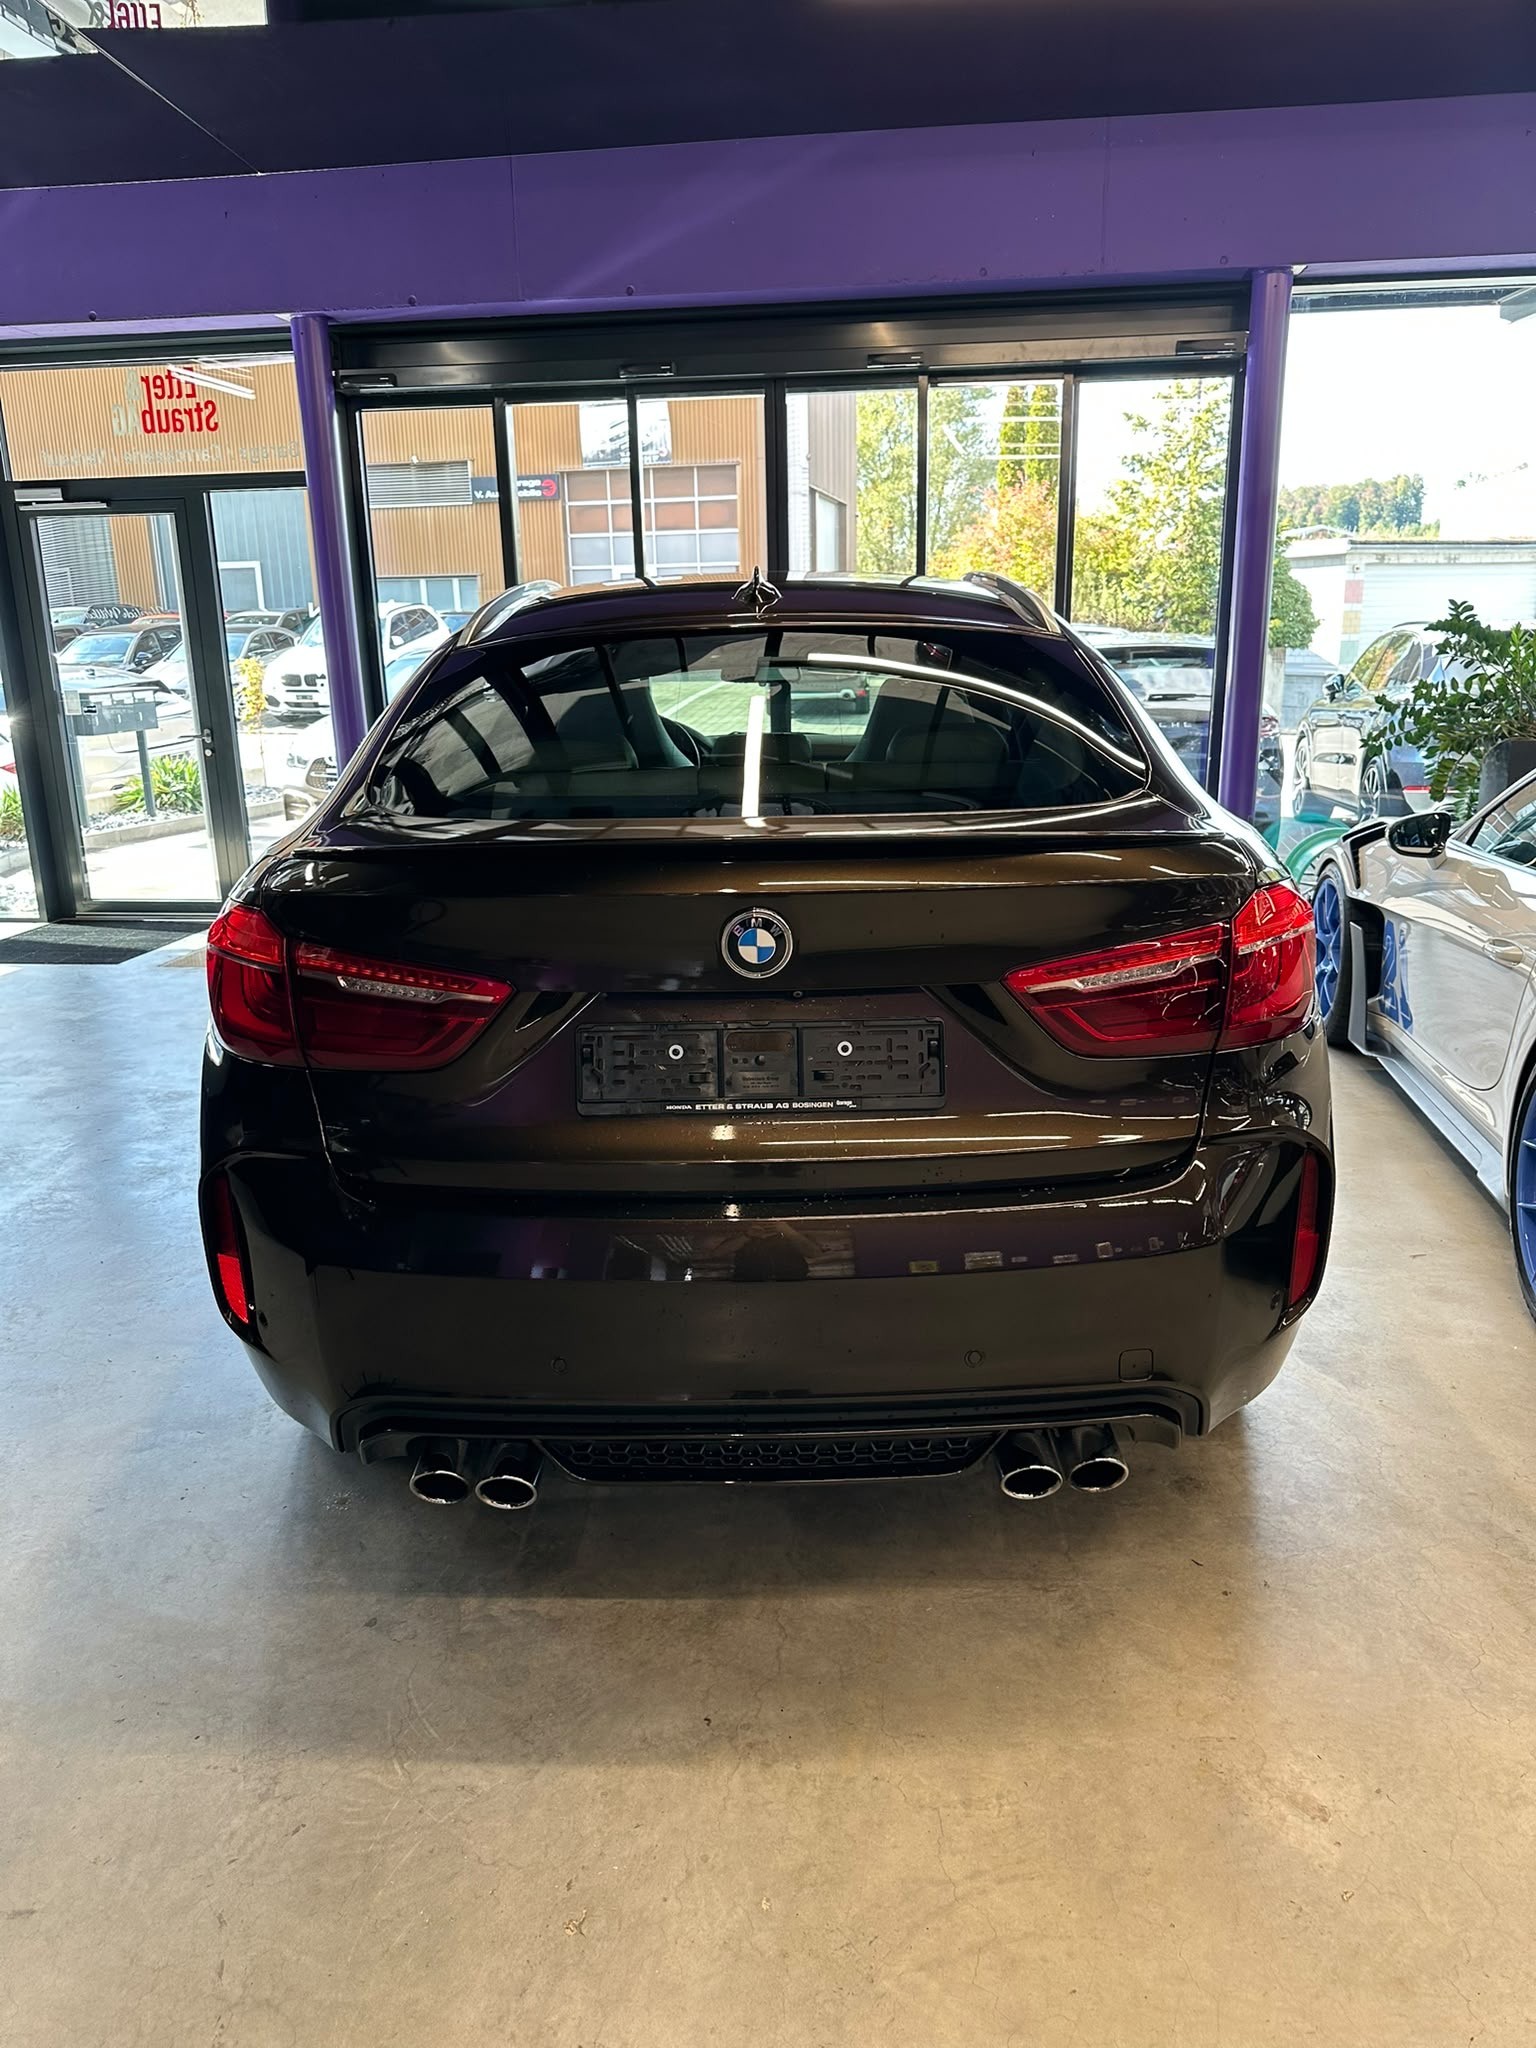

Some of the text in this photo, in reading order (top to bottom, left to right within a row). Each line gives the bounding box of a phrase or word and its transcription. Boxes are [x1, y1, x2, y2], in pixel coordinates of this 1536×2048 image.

[732, 917, 783, 938] BMW
[735, 1102, 774, 1110] STRAUB
[775, 1102, 790, 1110] AG
